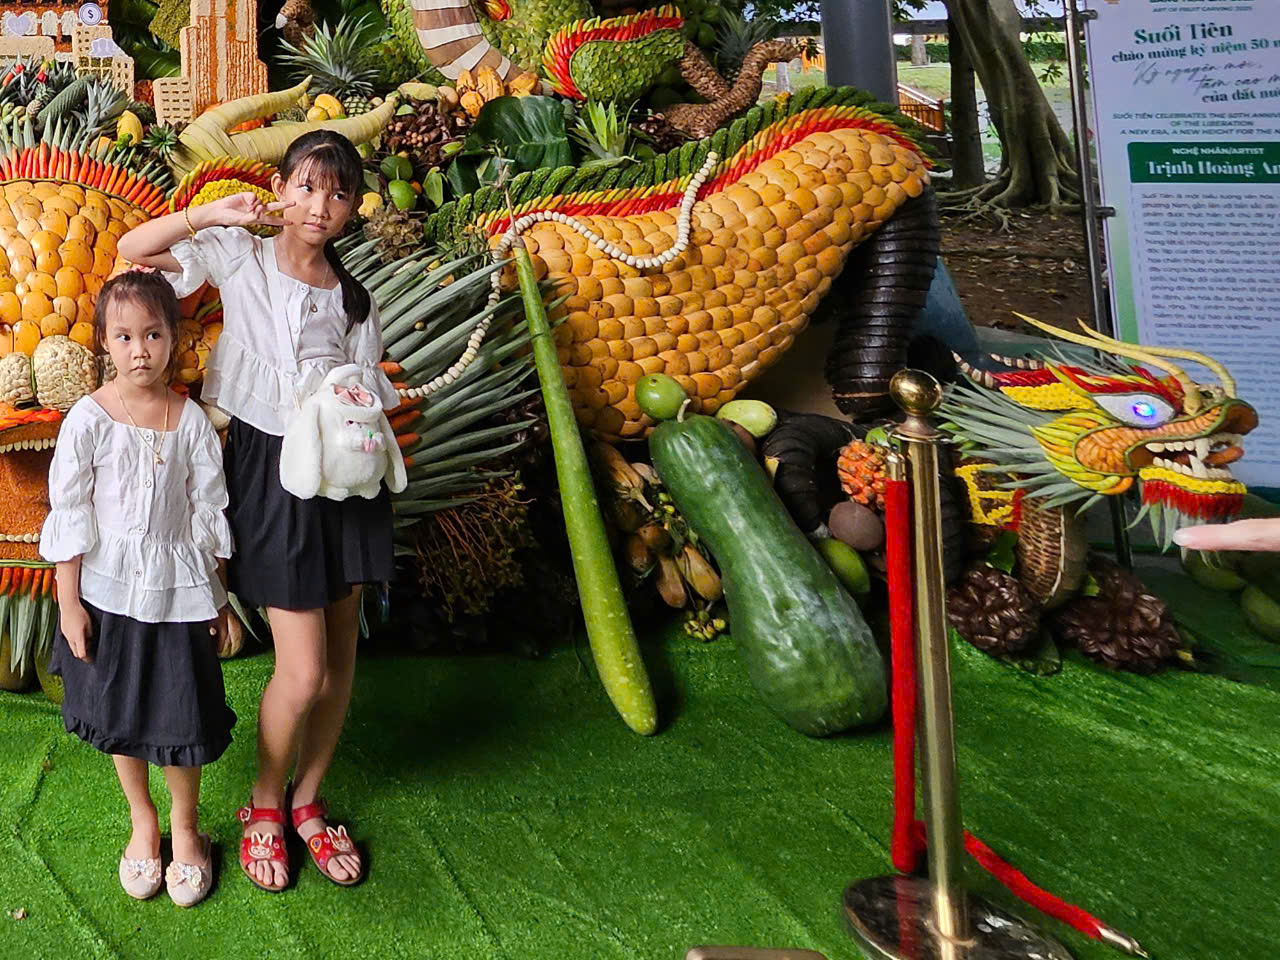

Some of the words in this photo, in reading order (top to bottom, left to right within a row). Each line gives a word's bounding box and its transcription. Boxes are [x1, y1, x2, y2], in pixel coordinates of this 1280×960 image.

[1134, 24, 1181, 45] Suối
[1187, 22, 1233, 40] Tiên
[1112, 50, 1145, 63] chào
[1148, 46, 1187, 59] mừng
[1212, 41, 1248, 55] niệm
[1251, 38, 1269, 50] 50
[1201, 90, 1228, 104] của
[1147, 161, 1194, 178] Trịnh
[1197, 161, 1256, 178] Hoàng
